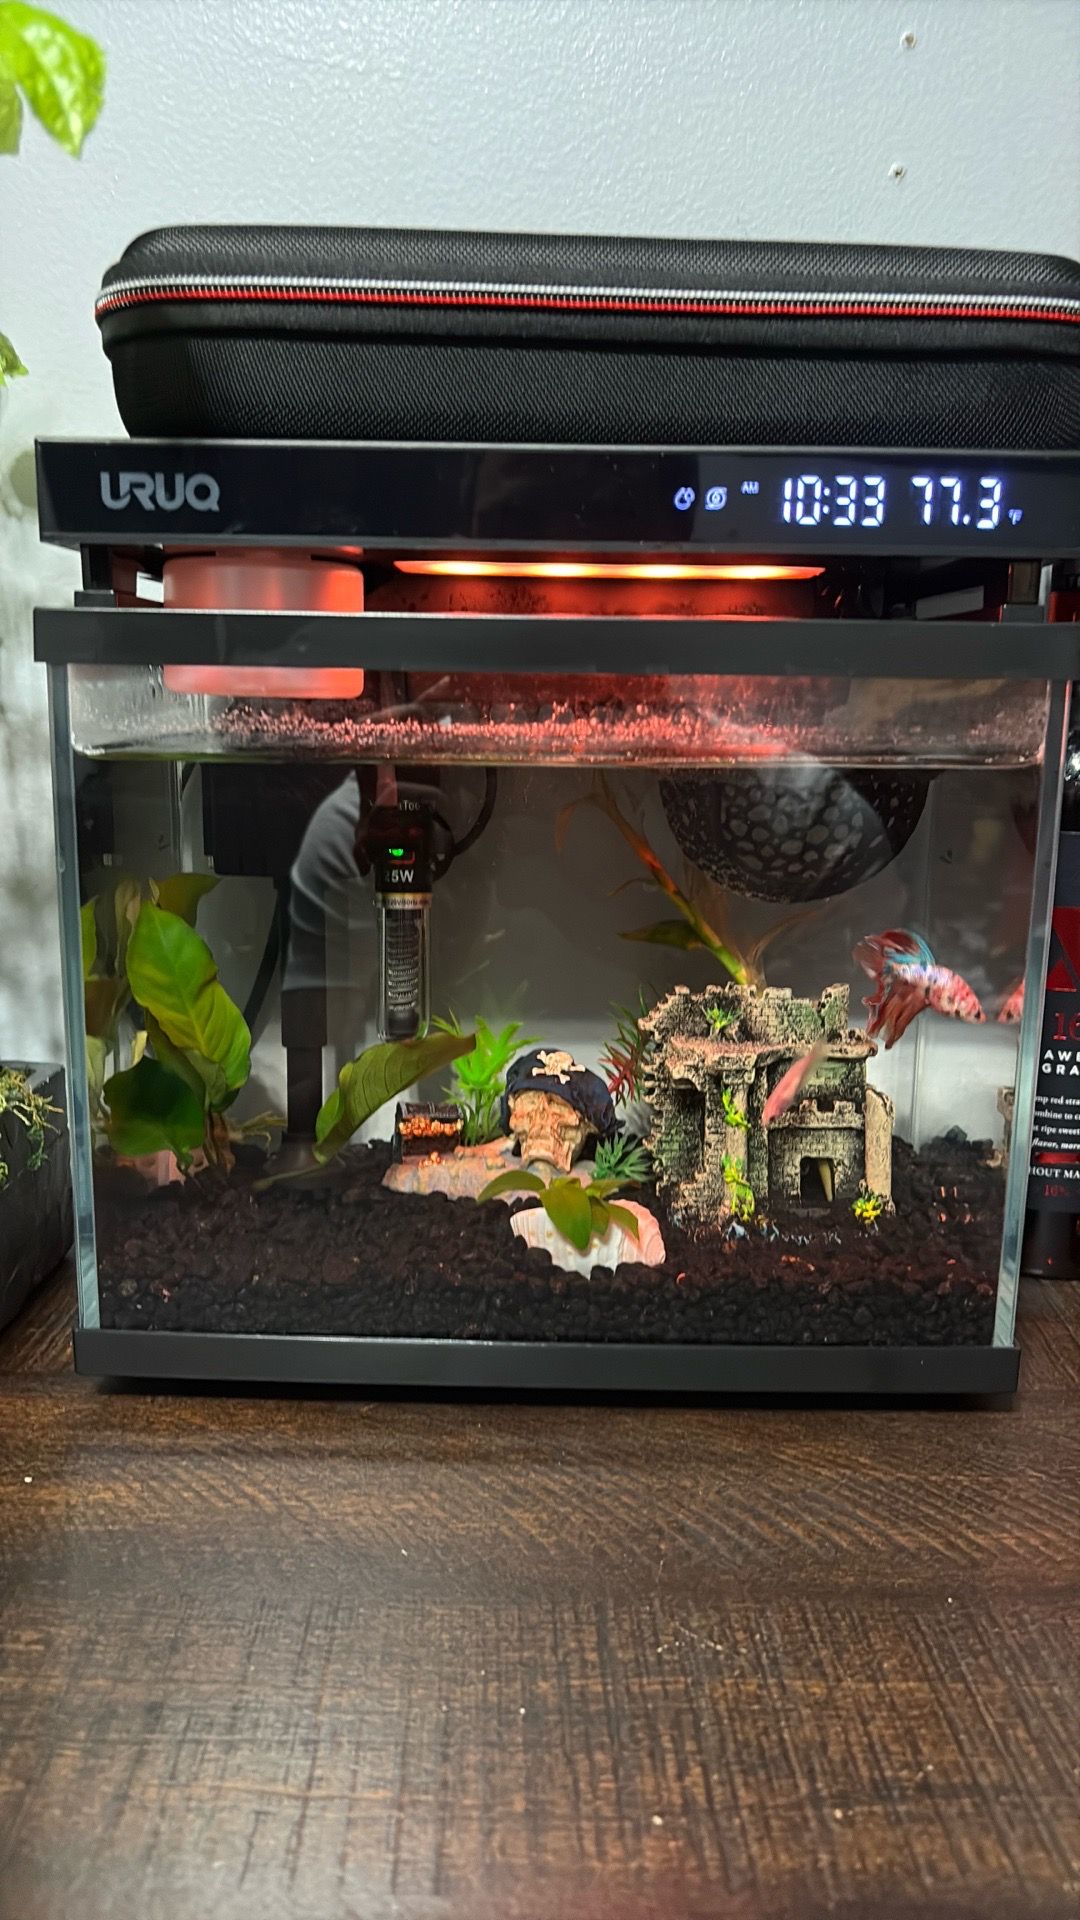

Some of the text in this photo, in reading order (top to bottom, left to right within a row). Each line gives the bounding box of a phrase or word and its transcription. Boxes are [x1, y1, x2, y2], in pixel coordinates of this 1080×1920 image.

[100, 471, 220, 512] URUQ
[741, 481, 760, 495] AM
[783, 475, 886, 526] 10:33
[911, 476, 1002, 529] 77.3
[1041, 1062, 1080, 1076] GRA
[1050, 1096, 1064, 1106] red
